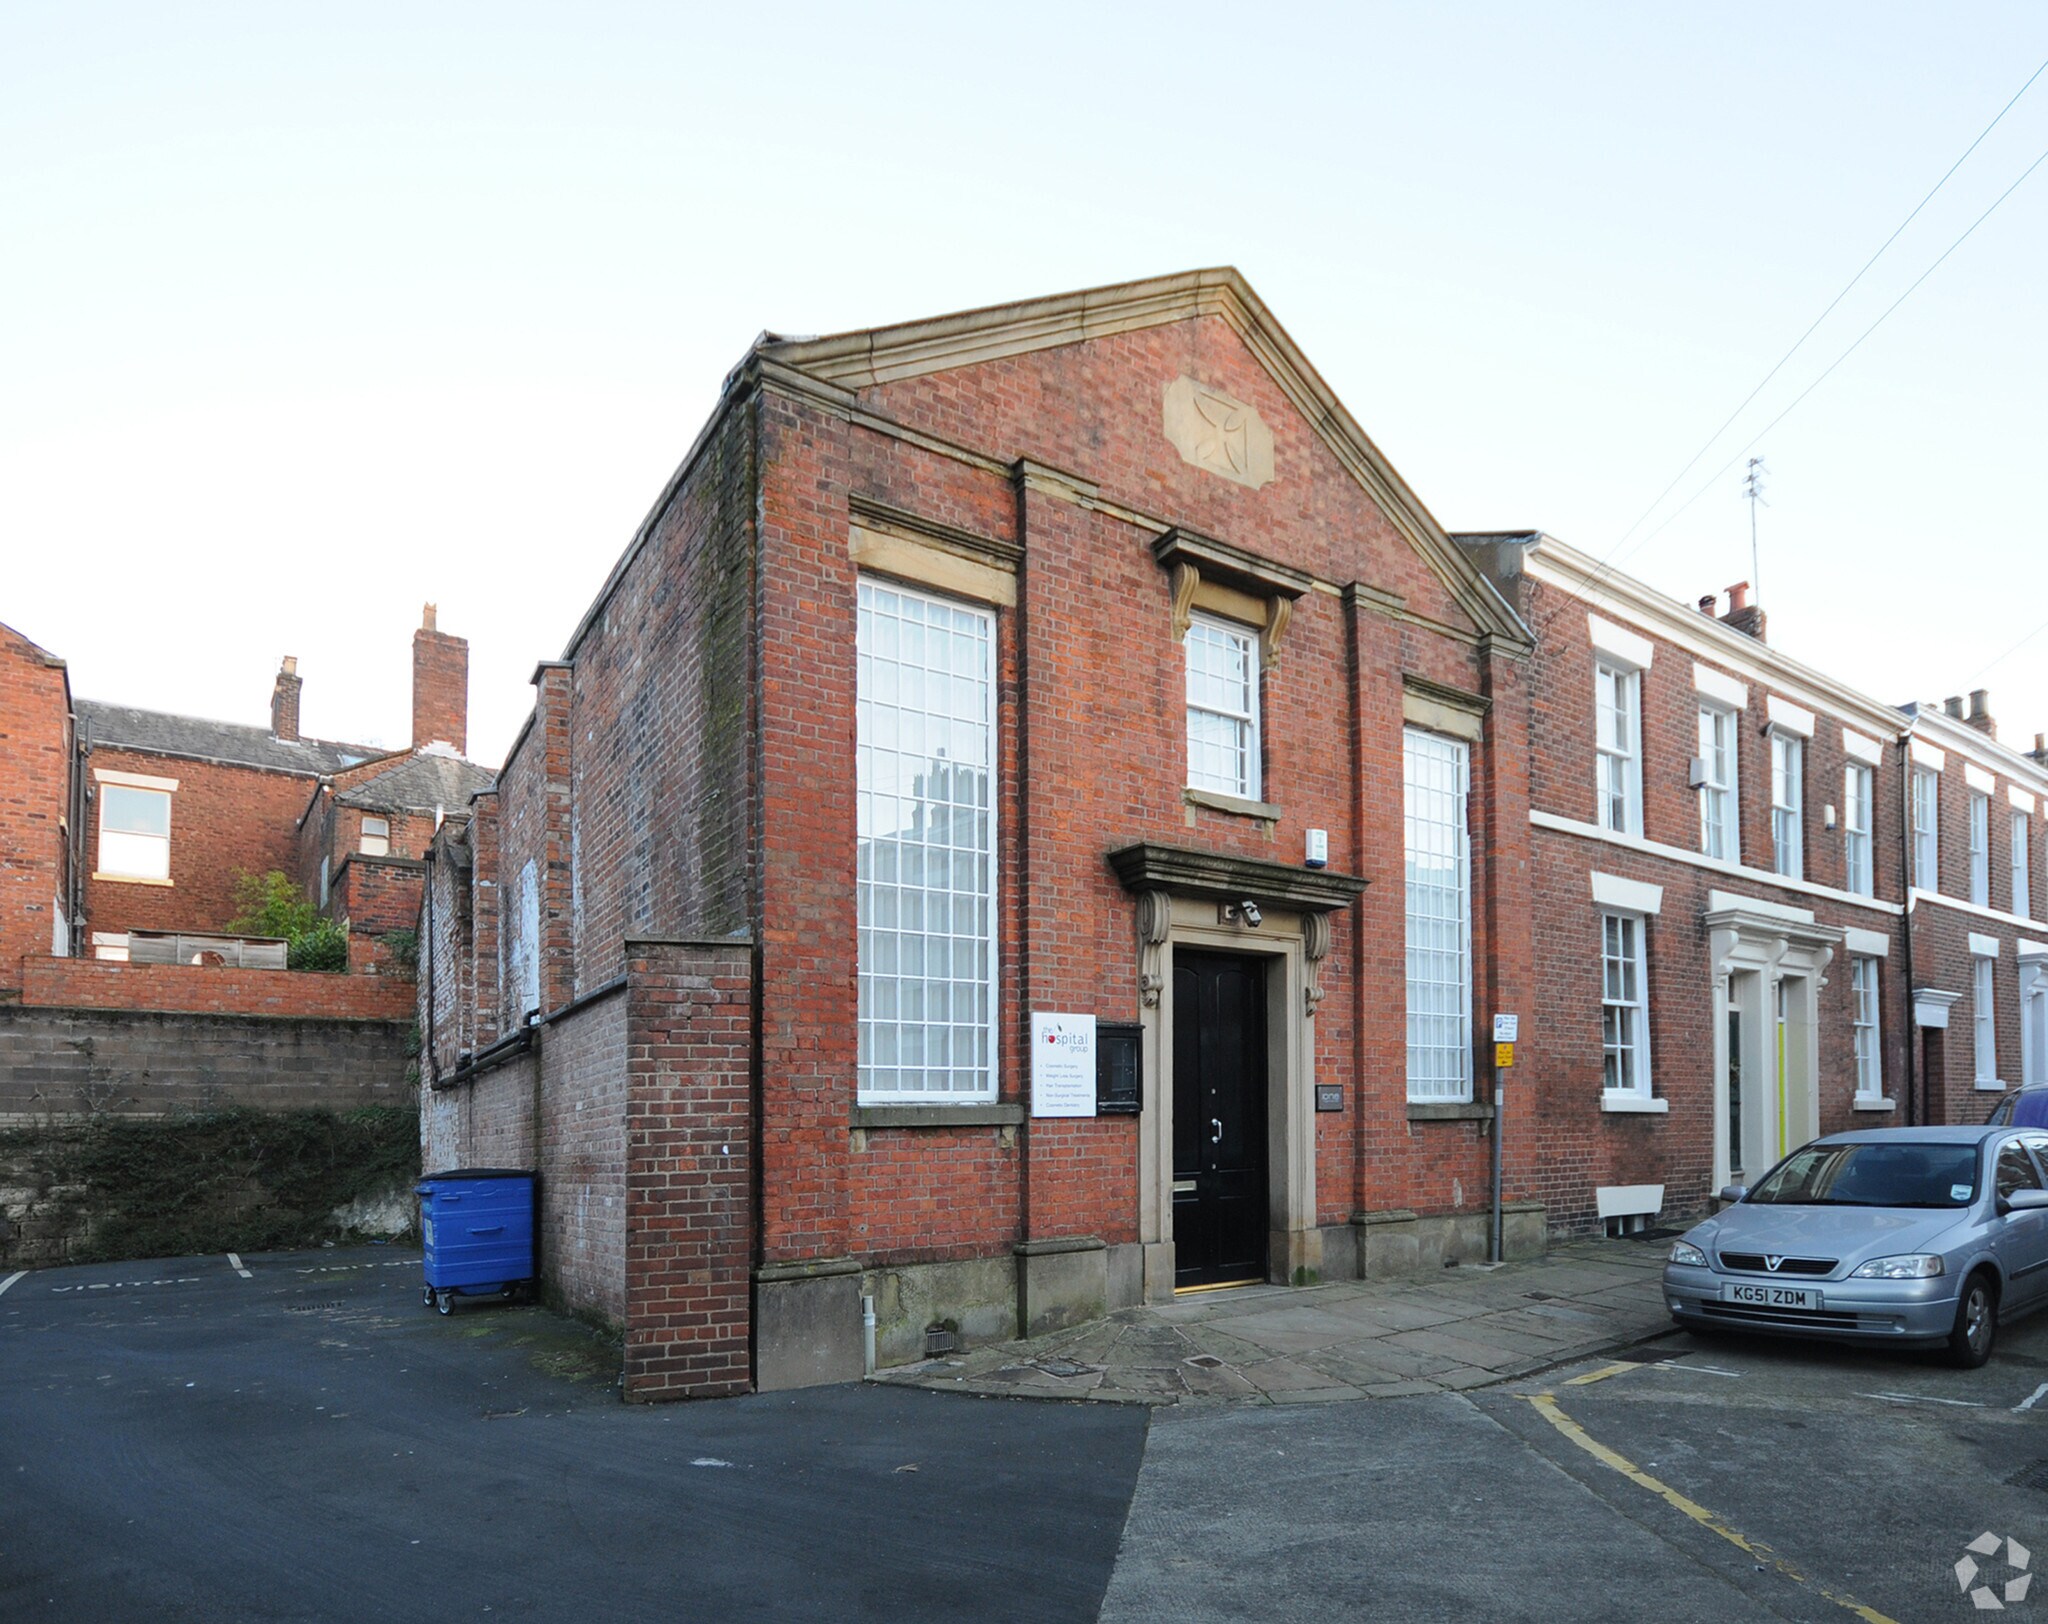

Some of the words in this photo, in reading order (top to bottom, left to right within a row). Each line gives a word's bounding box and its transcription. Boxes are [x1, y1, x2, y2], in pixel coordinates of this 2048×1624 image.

[1042, 1031, 1088, 1047] hospital
[1069, 1046, 1089, 1054] group
[1733, 1286, 1769, 1302] KG51
[1773, 1290, 1806, 1306] ZDM
